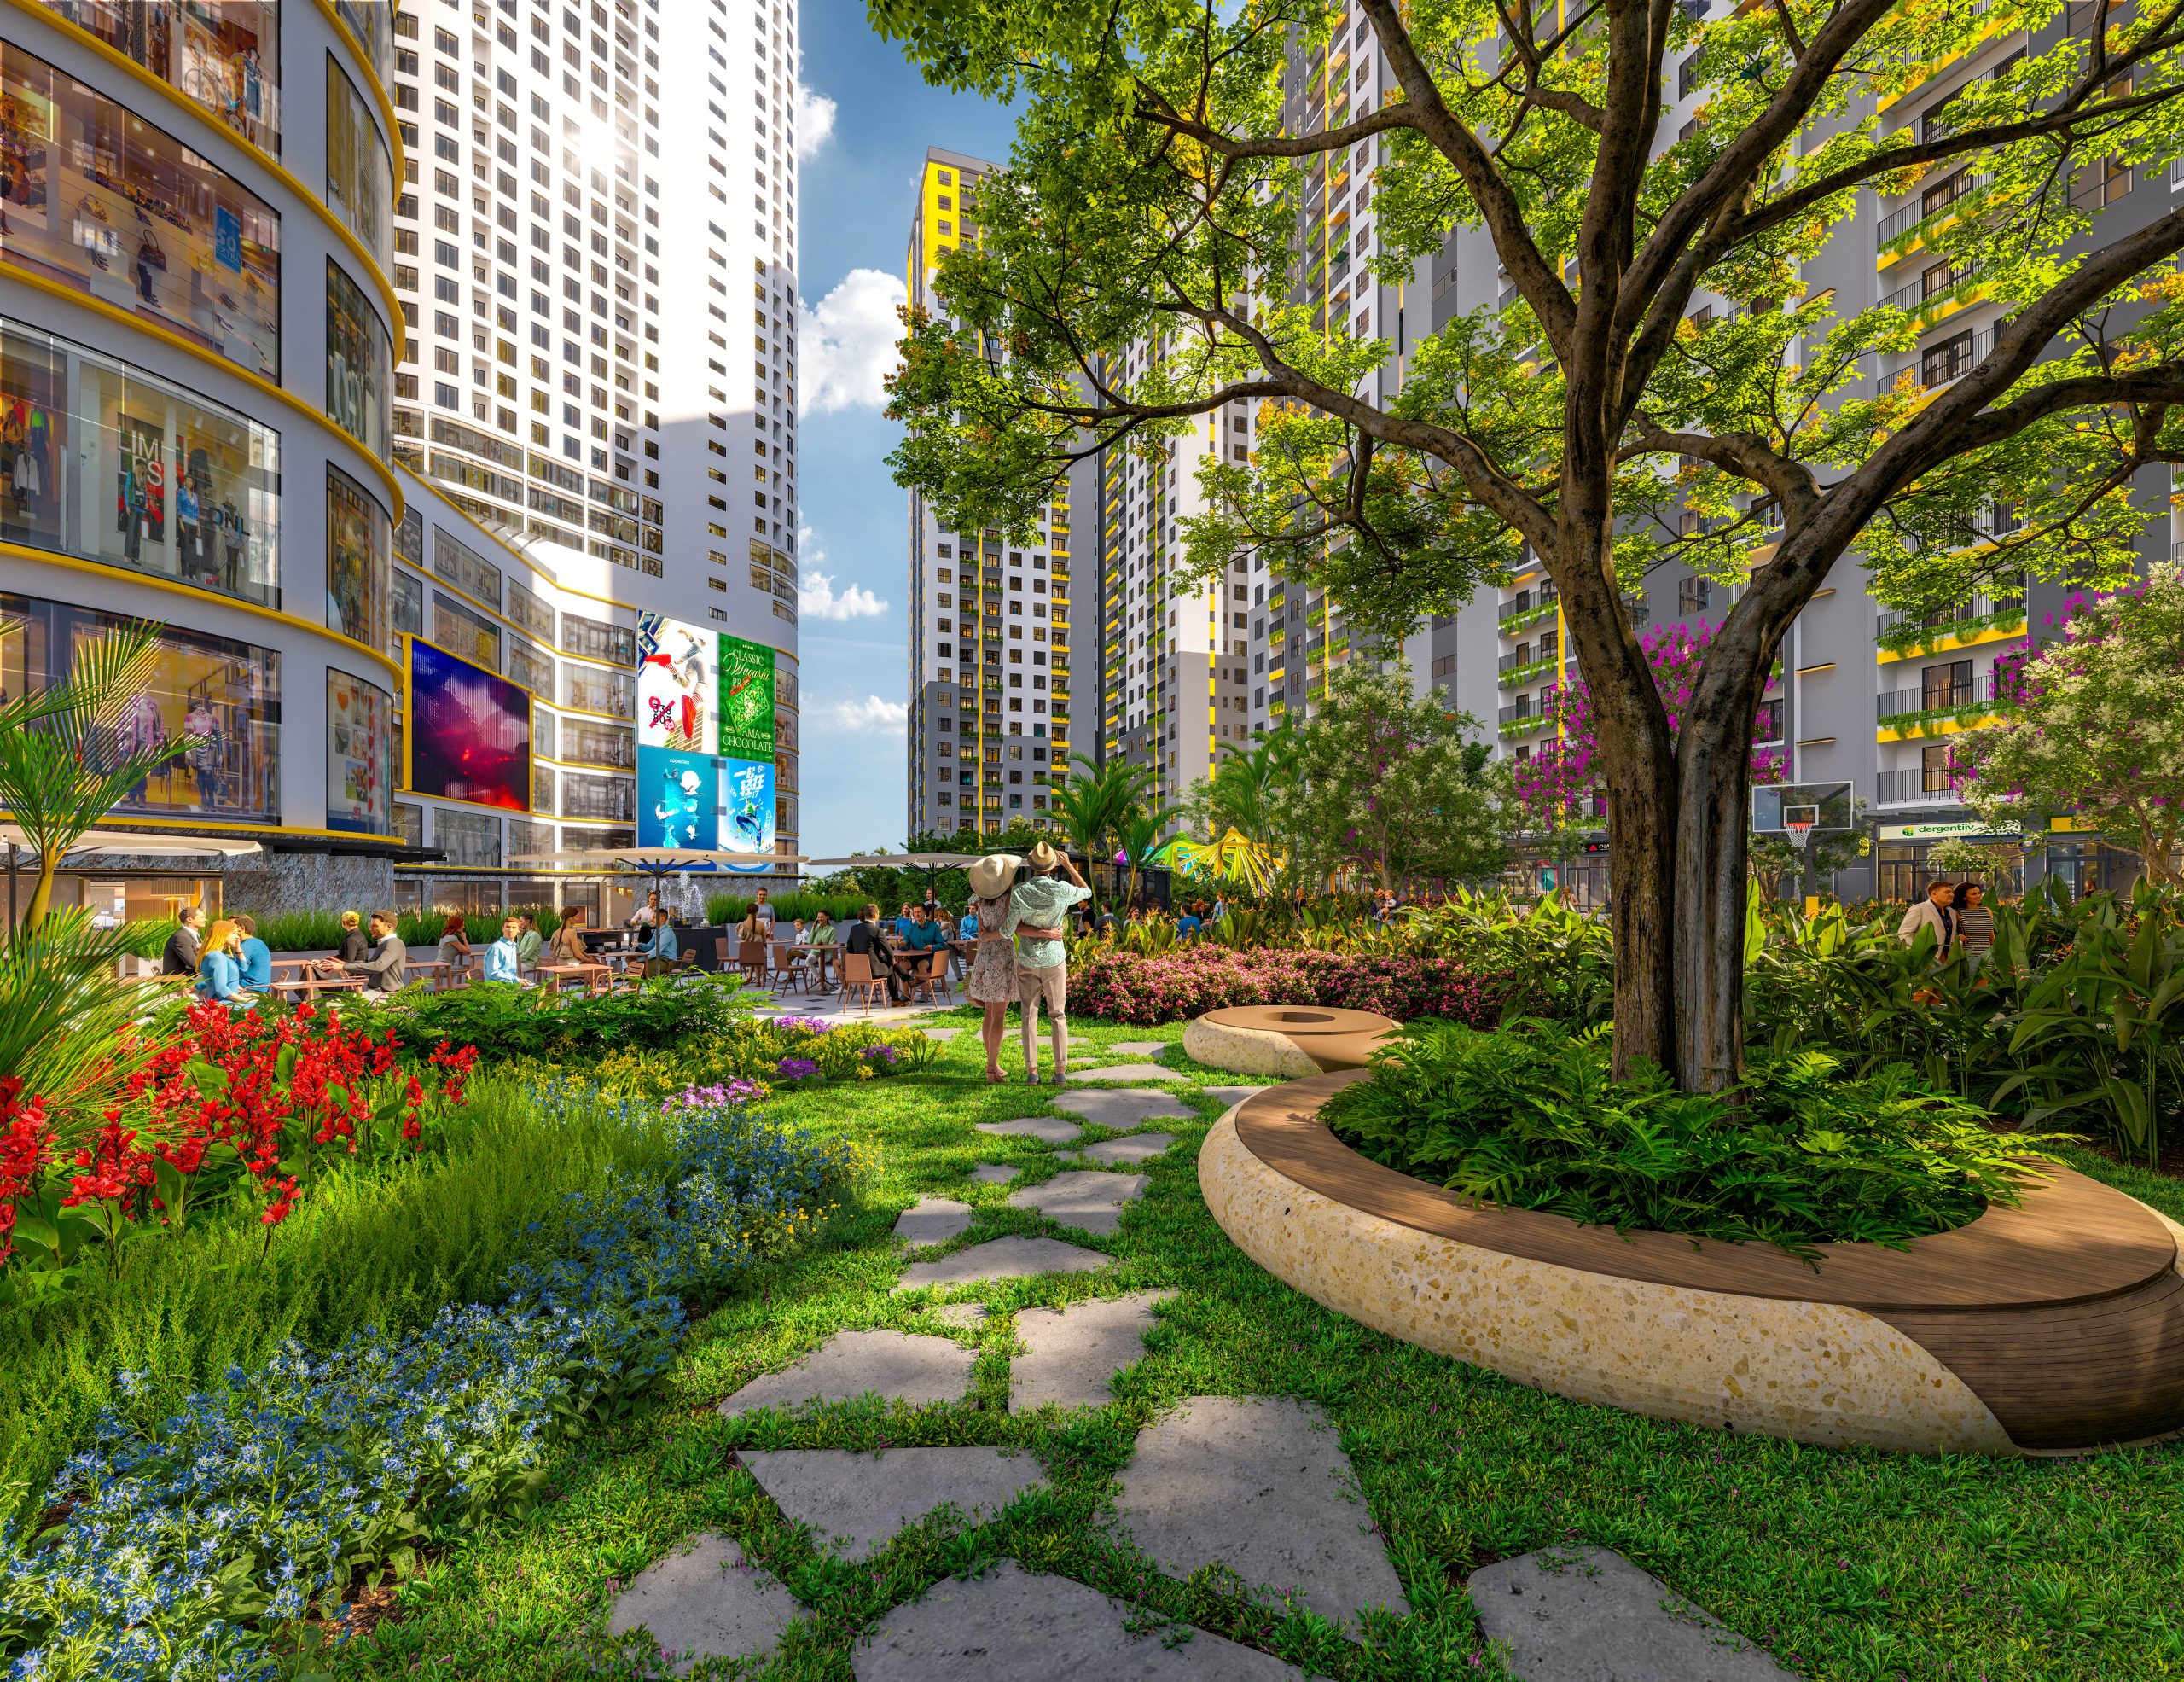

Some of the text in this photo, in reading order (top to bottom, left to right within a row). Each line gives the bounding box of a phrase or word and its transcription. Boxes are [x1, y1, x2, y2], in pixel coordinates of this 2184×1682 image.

[217, 243, 241, 265] EXTRA
[733, 649, 764, 666] CLASSIC
[740, 727, 761, 740] AMA
[722, 734, 773, 753] CHOCOLATE
